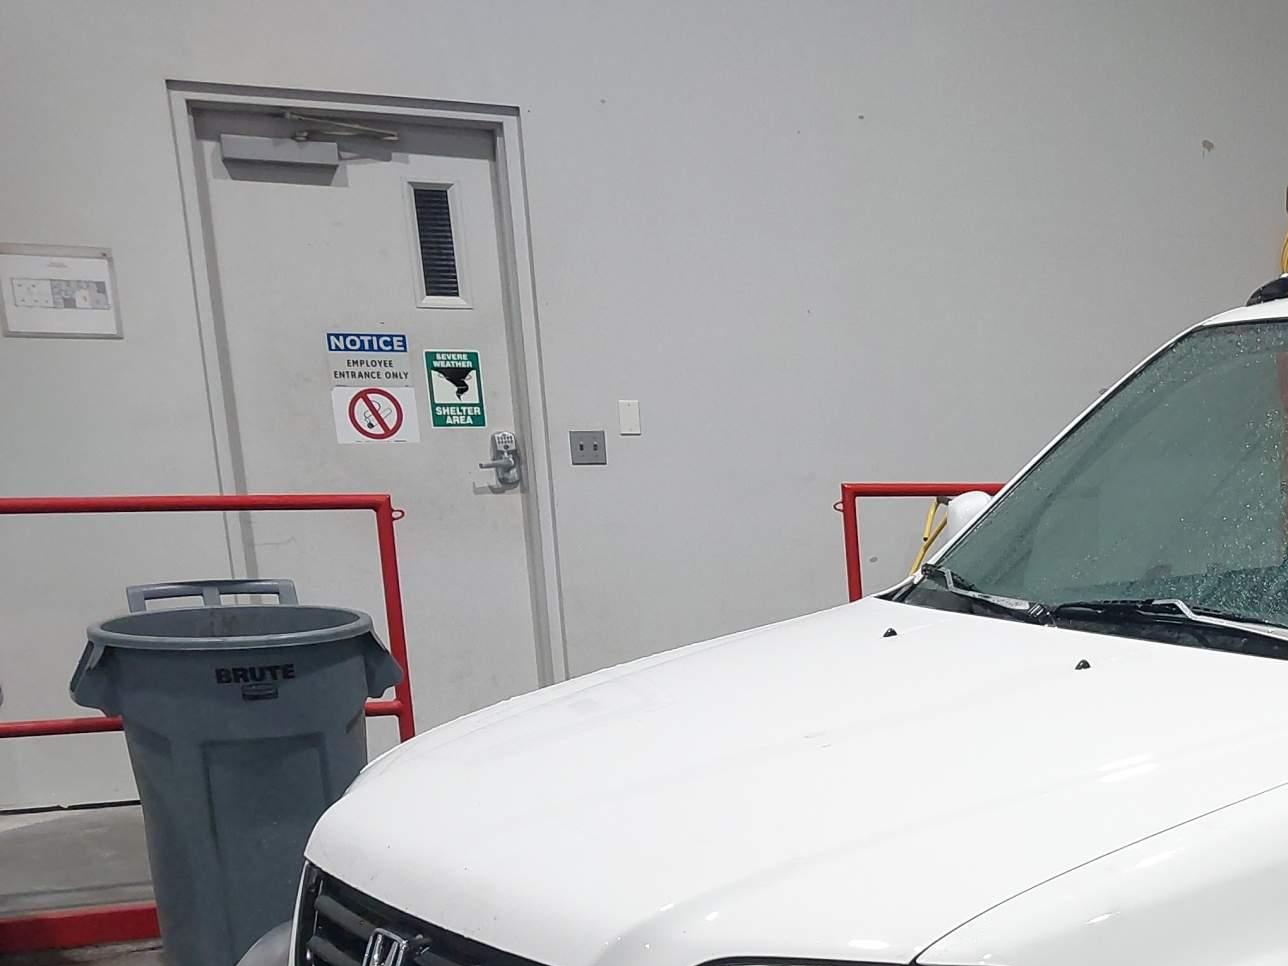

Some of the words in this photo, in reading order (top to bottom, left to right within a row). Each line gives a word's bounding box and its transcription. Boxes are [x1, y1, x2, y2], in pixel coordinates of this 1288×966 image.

[329, 335, 405, 351] NOTICE
[435, 353, 469, 361] SEVERE
[346, 359, 393, 368] EMPLOYEE
[432, 360, 473, 368] WEATHER
[333, 370, 381, 379] ENTRANCE
[384, 371, 409, 380] ONLY
[435, 406, 481, 416] SHELTER
[446, 415, 474, 425] AREA
[215, 663, 295, 684] BRUTE
